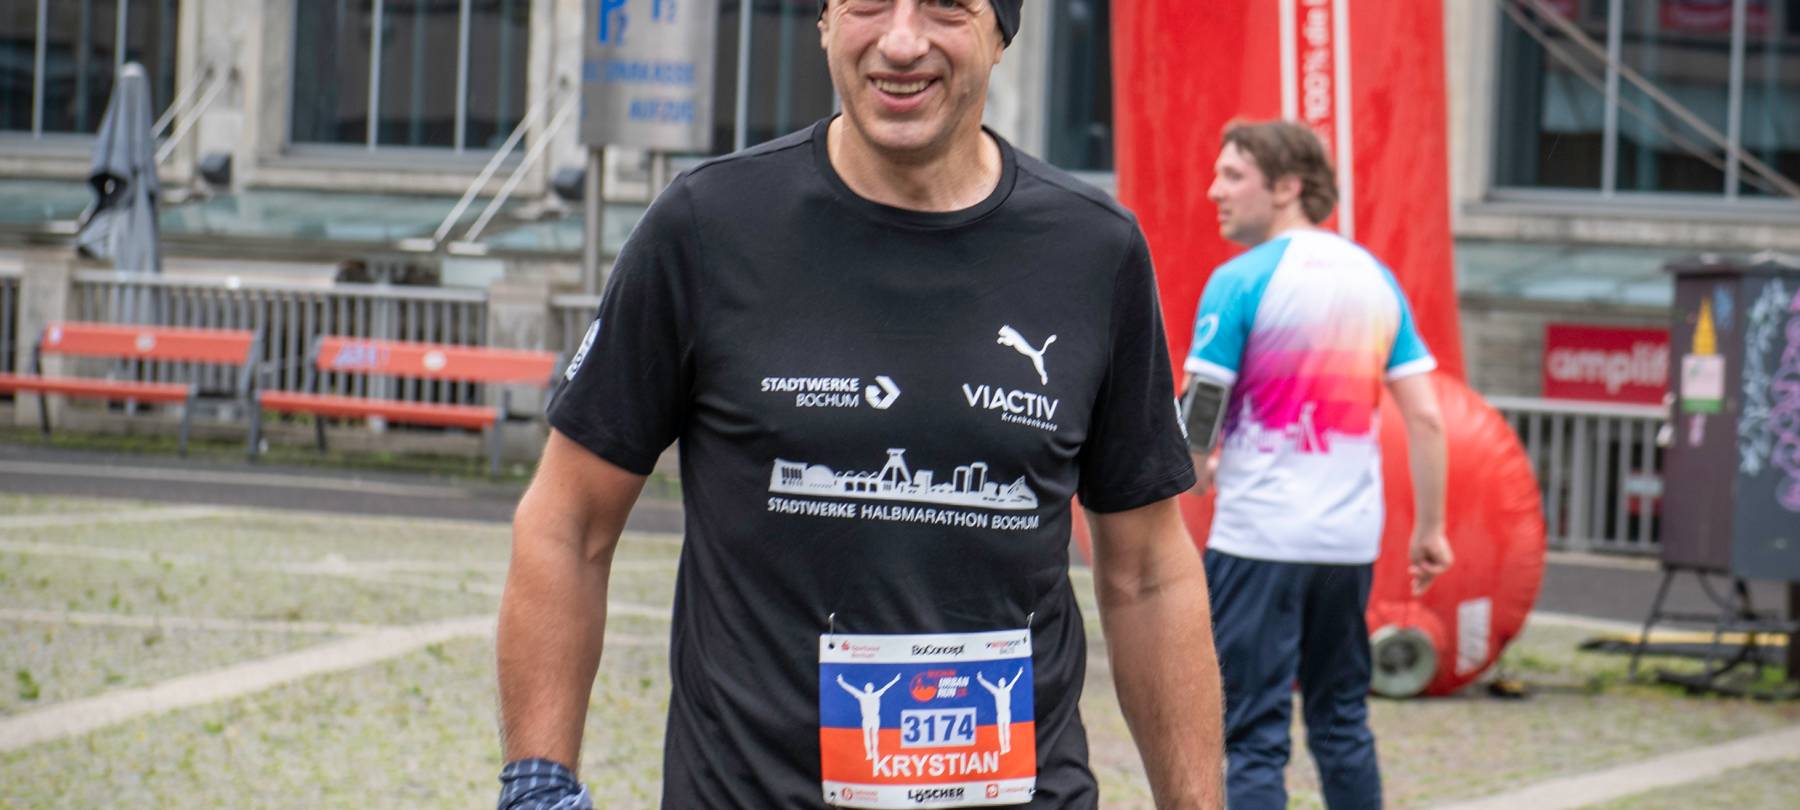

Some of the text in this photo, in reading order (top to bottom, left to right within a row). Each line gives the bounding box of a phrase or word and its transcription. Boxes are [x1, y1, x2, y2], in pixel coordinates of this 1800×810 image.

[761, 377, 860, 392] STADTWERKE
[796, 393, 860, 408] BOCHUM
[962, 383, 1058, 420] VIACTIV
[1001, 411, 1058, 432] Krankenkasse
[767, 497, 1039, 531] STADTWERKE HALBMARATHON BOCHUM
[903, 714, 974, 743] 3174
[872, 750, 1000, 778] KRYSTIAN
